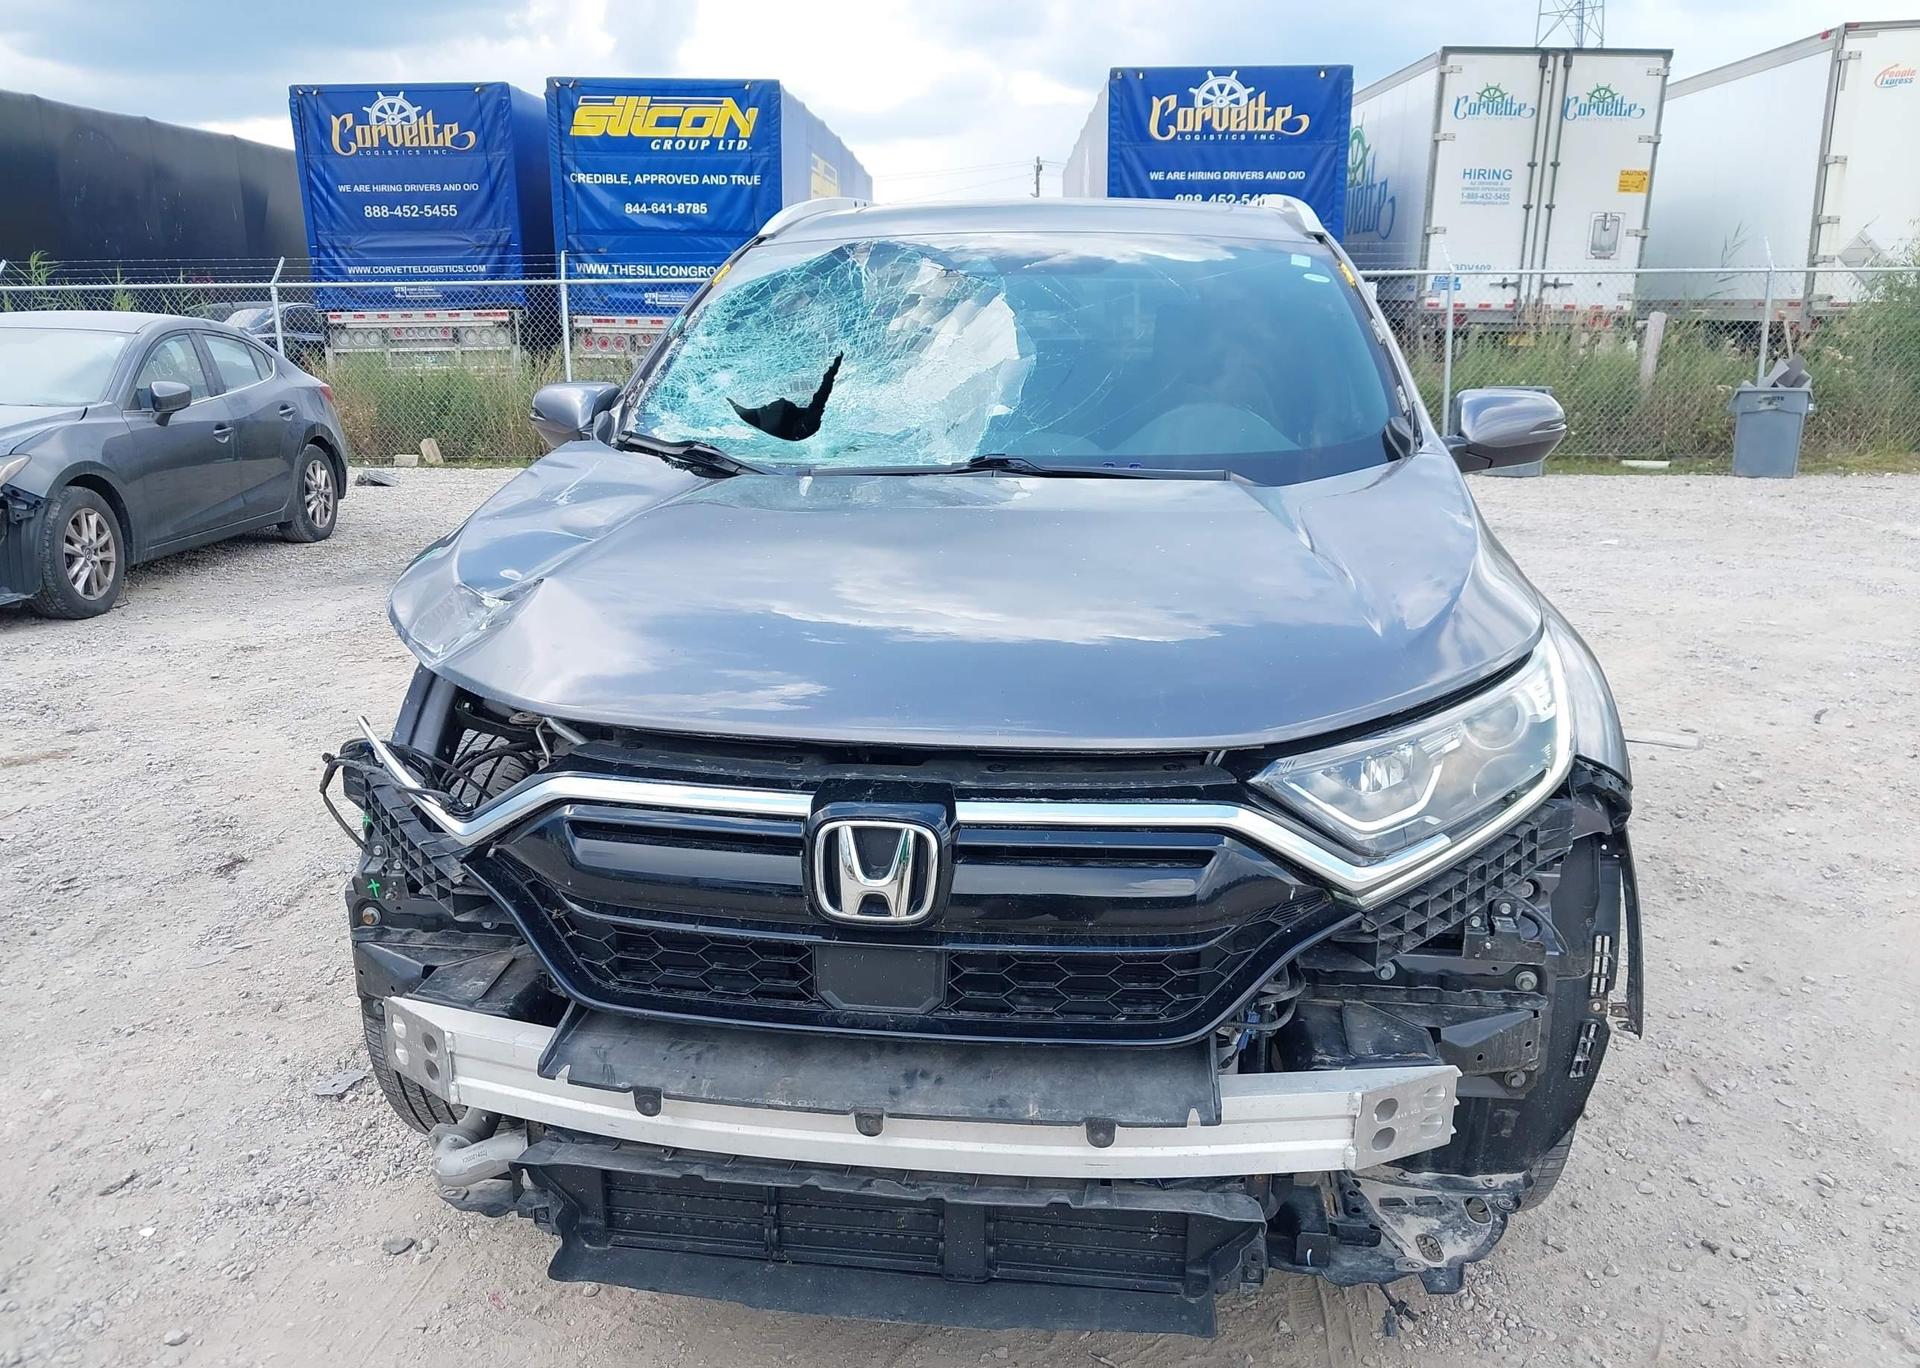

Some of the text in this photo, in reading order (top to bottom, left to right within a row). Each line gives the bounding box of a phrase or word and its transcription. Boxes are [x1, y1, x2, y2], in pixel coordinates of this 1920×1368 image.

[1453, 94, 1536, 120] Corvette
[1563, 94, 1646, 121] Corvette
[1149, 91, 1310, 141] Corvette
[330, 109, 477, 156] Corvette
[650, 139, 753, 150] GROUP LTD.
[569, 172, 761, 186] CREDIBLE, APPROVED AND TRUE
[1150, 170, 1306, 180] WE ARE HIRING DRIVERS AND O/O
[1462, 168, 1513, 180] HIRING
[338, 183, 479, 194] WE ARE HIRING DRIVERS AND O/O
[363, 204, 458, 218] 888-452-5455
[624, 203, 708, 215] 844-641-8785
[347, 265, 487, 274] WWW.CORVETTELOGISTICS.COM
[575, 263, 720, 277] WWW.THESILICONGRO
